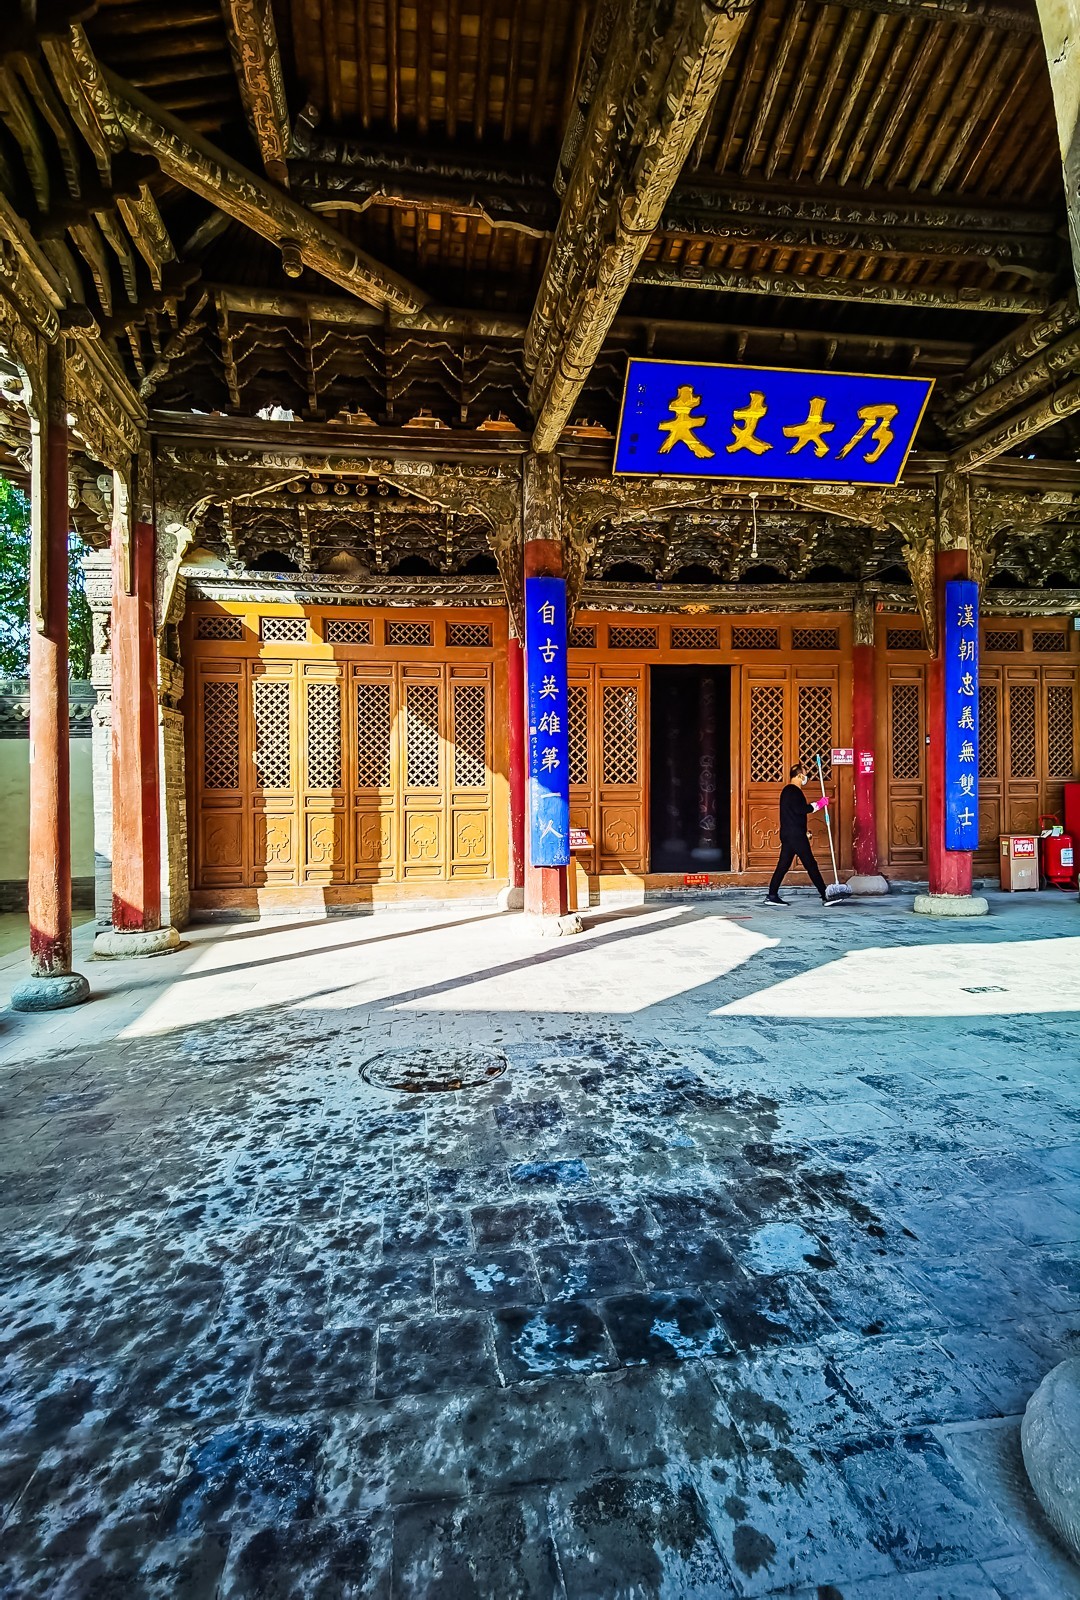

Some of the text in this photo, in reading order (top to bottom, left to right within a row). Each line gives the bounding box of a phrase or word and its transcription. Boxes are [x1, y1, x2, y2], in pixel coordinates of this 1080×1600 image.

[537, 600, 563, 839] 自古英雄第一人
[956, 604, 976, 826] 漢朝忠義無雙士
